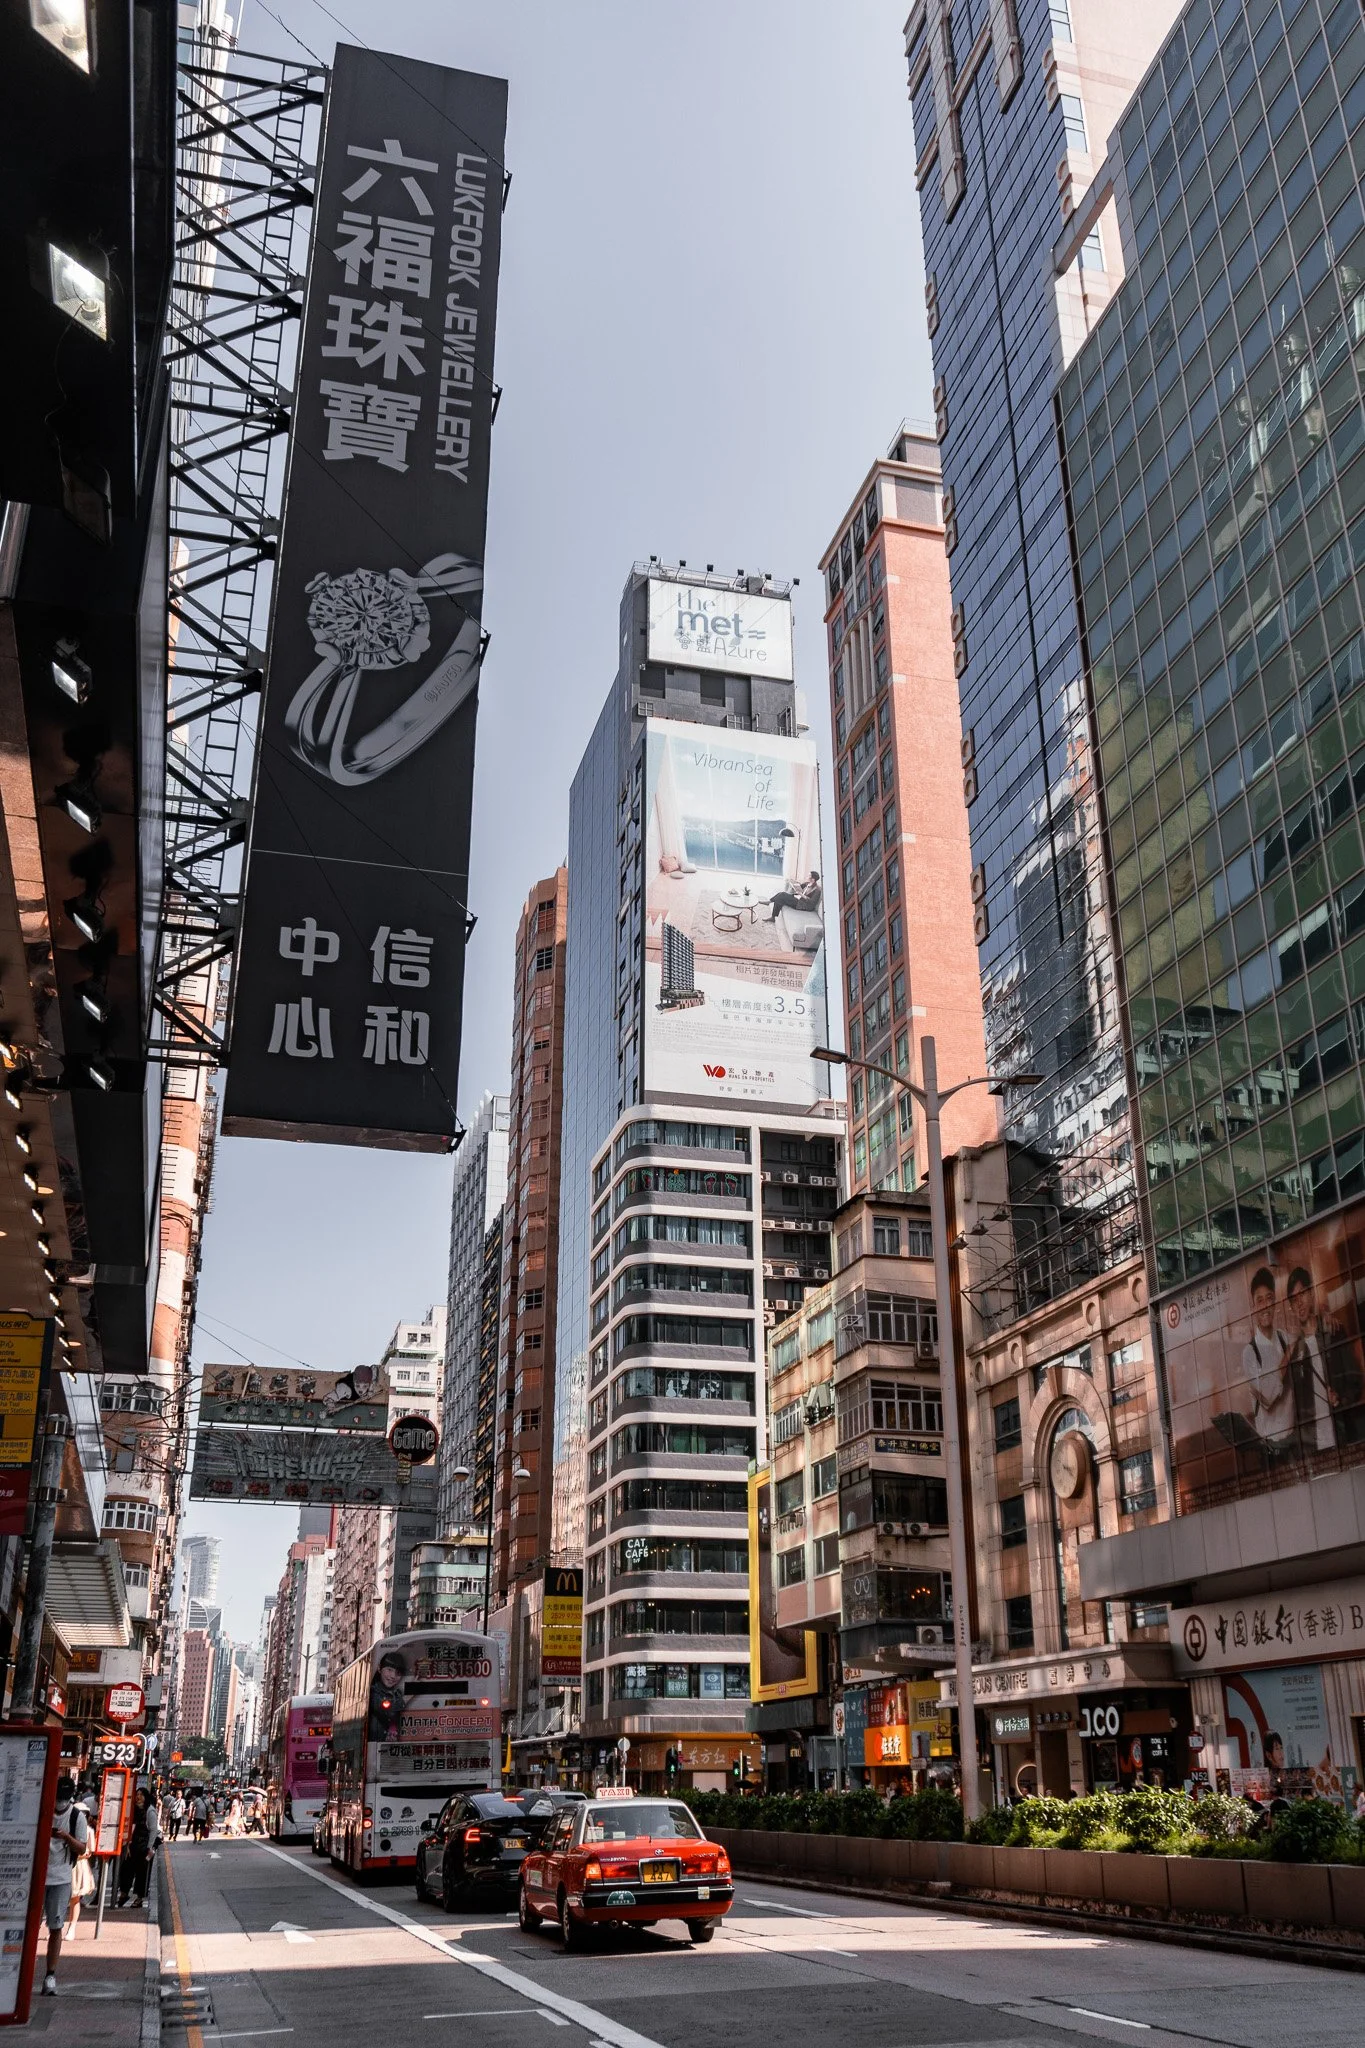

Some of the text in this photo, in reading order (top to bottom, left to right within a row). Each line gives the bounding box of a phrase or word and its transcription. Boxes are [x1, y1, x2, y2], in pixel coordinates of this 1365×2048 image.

[319, 139, 439, 473] 六福珠寶
[434, 152, 487, 483] LUKFOOK JEWELLERY
[713, 636, 767, 661] Azure
[755, 779, 773, 793] of
[747, 795, 774, 811] Life
[268, 917, 340, 1059] 中心
[363, 925, 434, 1066] 信和
[627, 1538, 646, 1549] CAT
[994, 1671, 1028, 1692] CENTRE
[1078, 1706, 1120, 1738] J.CO
[102, 1743, 135, 1761] S23
[1191, 1771, 1208, 1782] N52
[600, 1788, 631, 1797] TAXI
